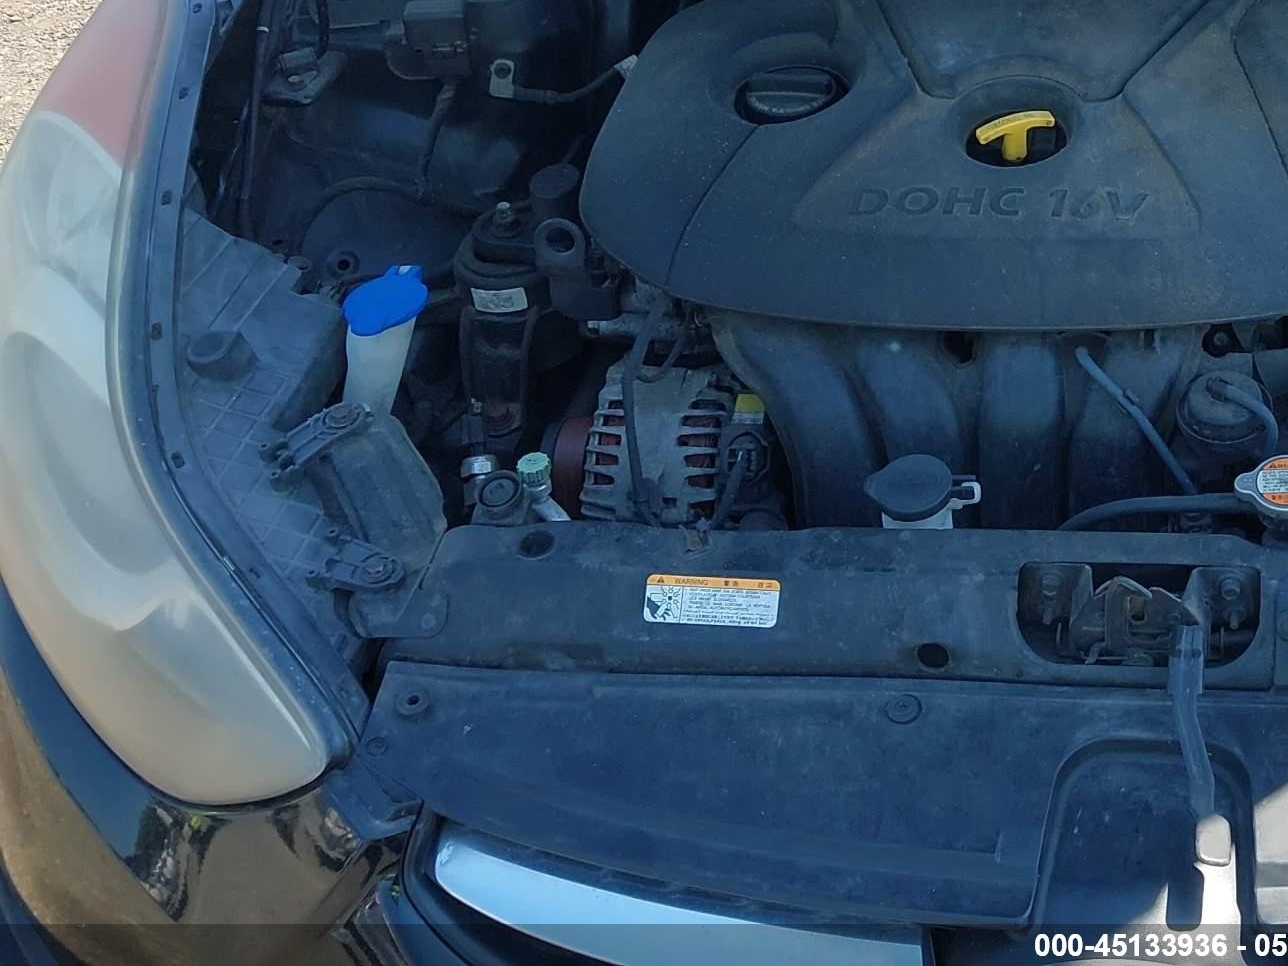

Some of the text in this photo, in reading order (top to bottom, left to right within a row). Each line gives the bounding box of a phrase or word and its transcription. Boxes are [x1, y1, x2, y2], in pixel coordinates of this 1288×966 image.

[848, 186, 1150, 222] DOHC 16V
[674, 577, 709, 586] WARNING
